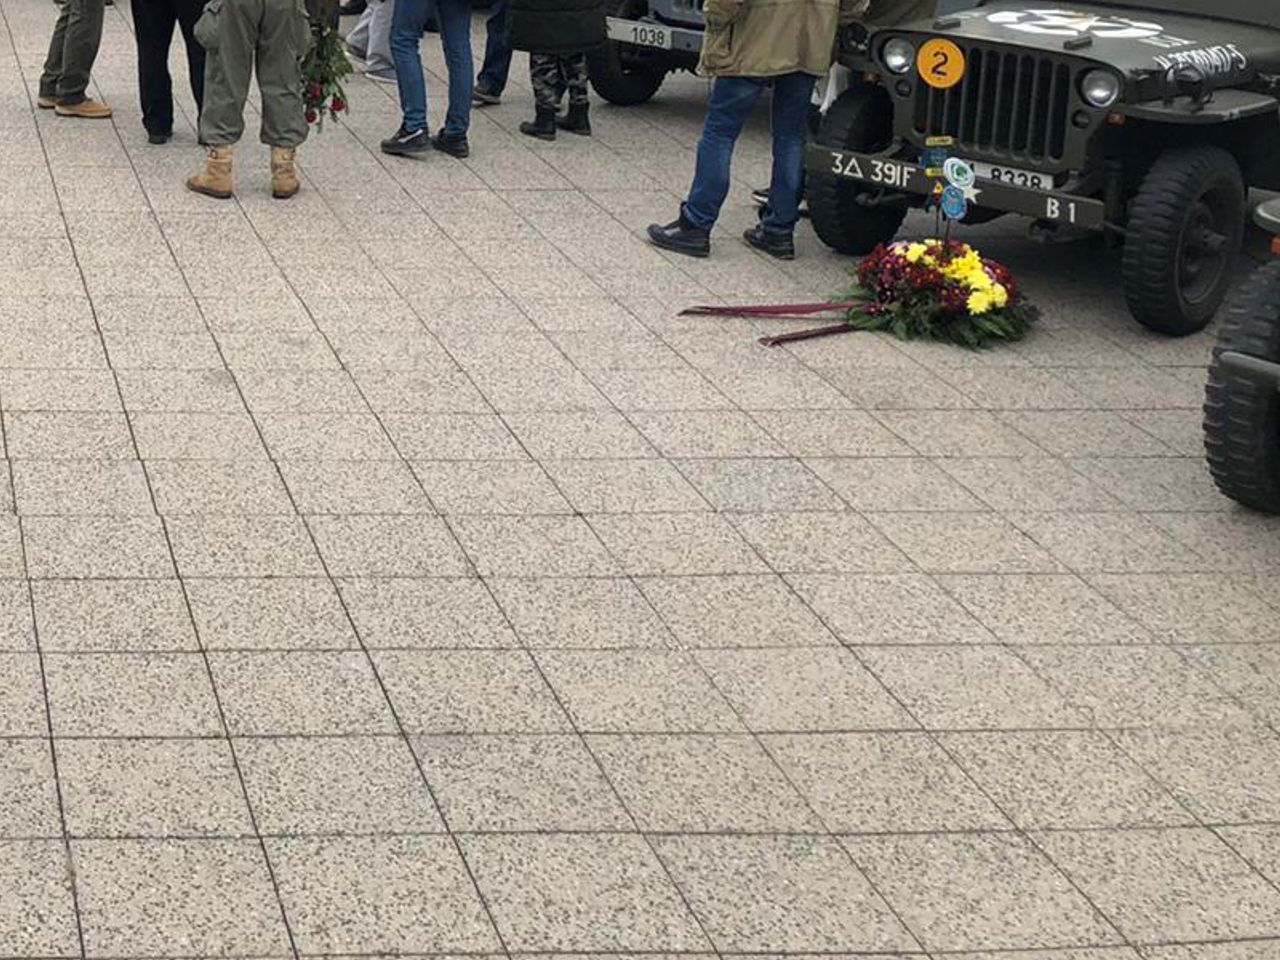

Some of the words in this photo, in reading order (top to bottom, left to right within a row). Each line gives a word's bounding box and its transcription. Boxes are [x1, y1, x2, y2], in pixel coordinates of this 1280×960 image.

[631, 26, 665, 46] 1038
[931, 50, 949, 77] 2
[1046, 196, 1060, 219] B
[1068, 202, 1076, 224] 1
